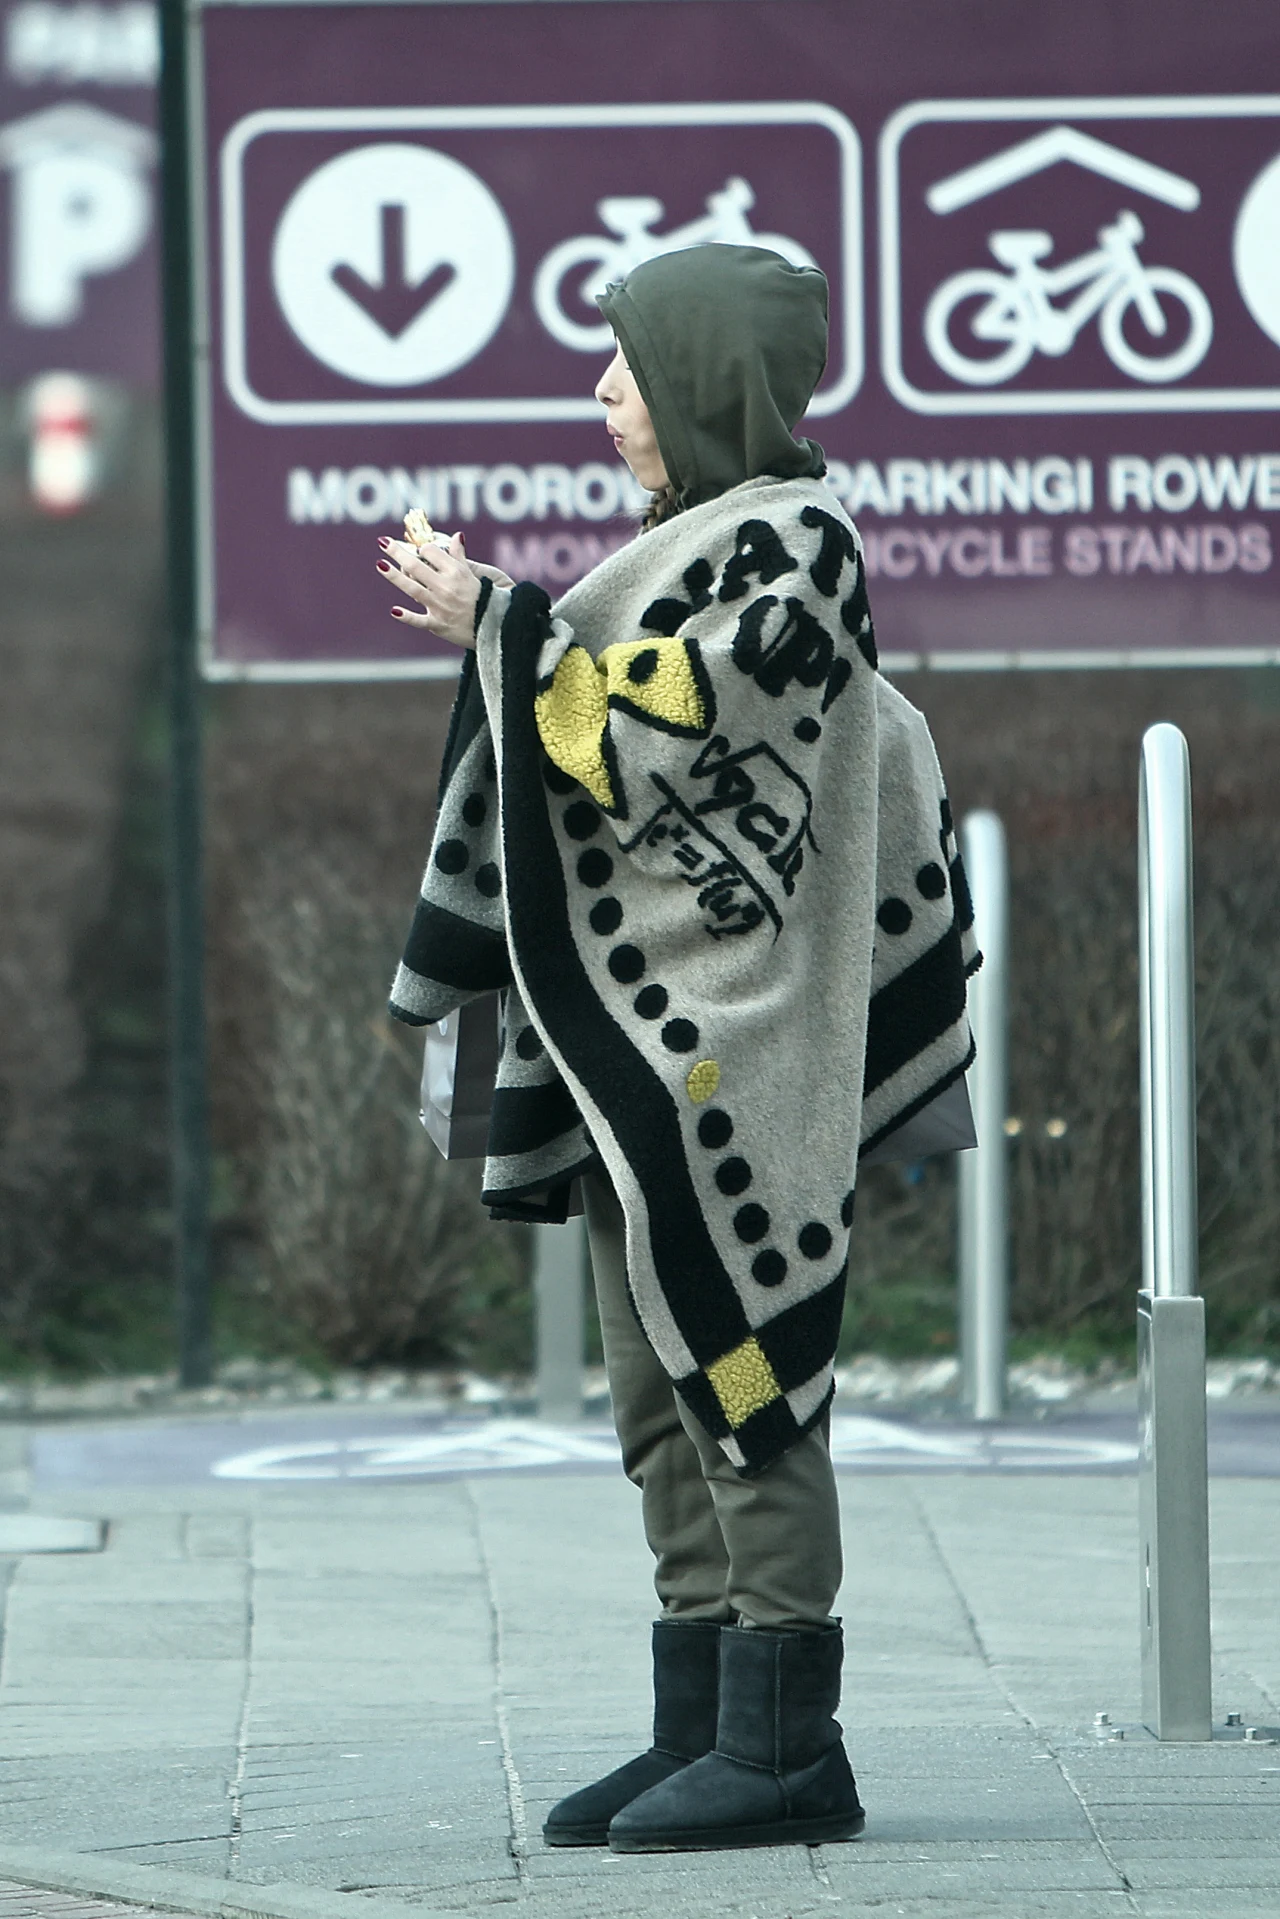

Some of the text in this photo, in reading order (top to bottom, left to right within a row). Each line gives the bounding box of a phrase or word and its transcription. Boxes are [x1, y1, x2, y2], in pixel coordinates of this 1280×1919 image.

[825, 457, 1094, 515] PARKINGI
[862, 525, 1054, 577] ICYCLE
[1064, 523, 1273, 576] STANDS
